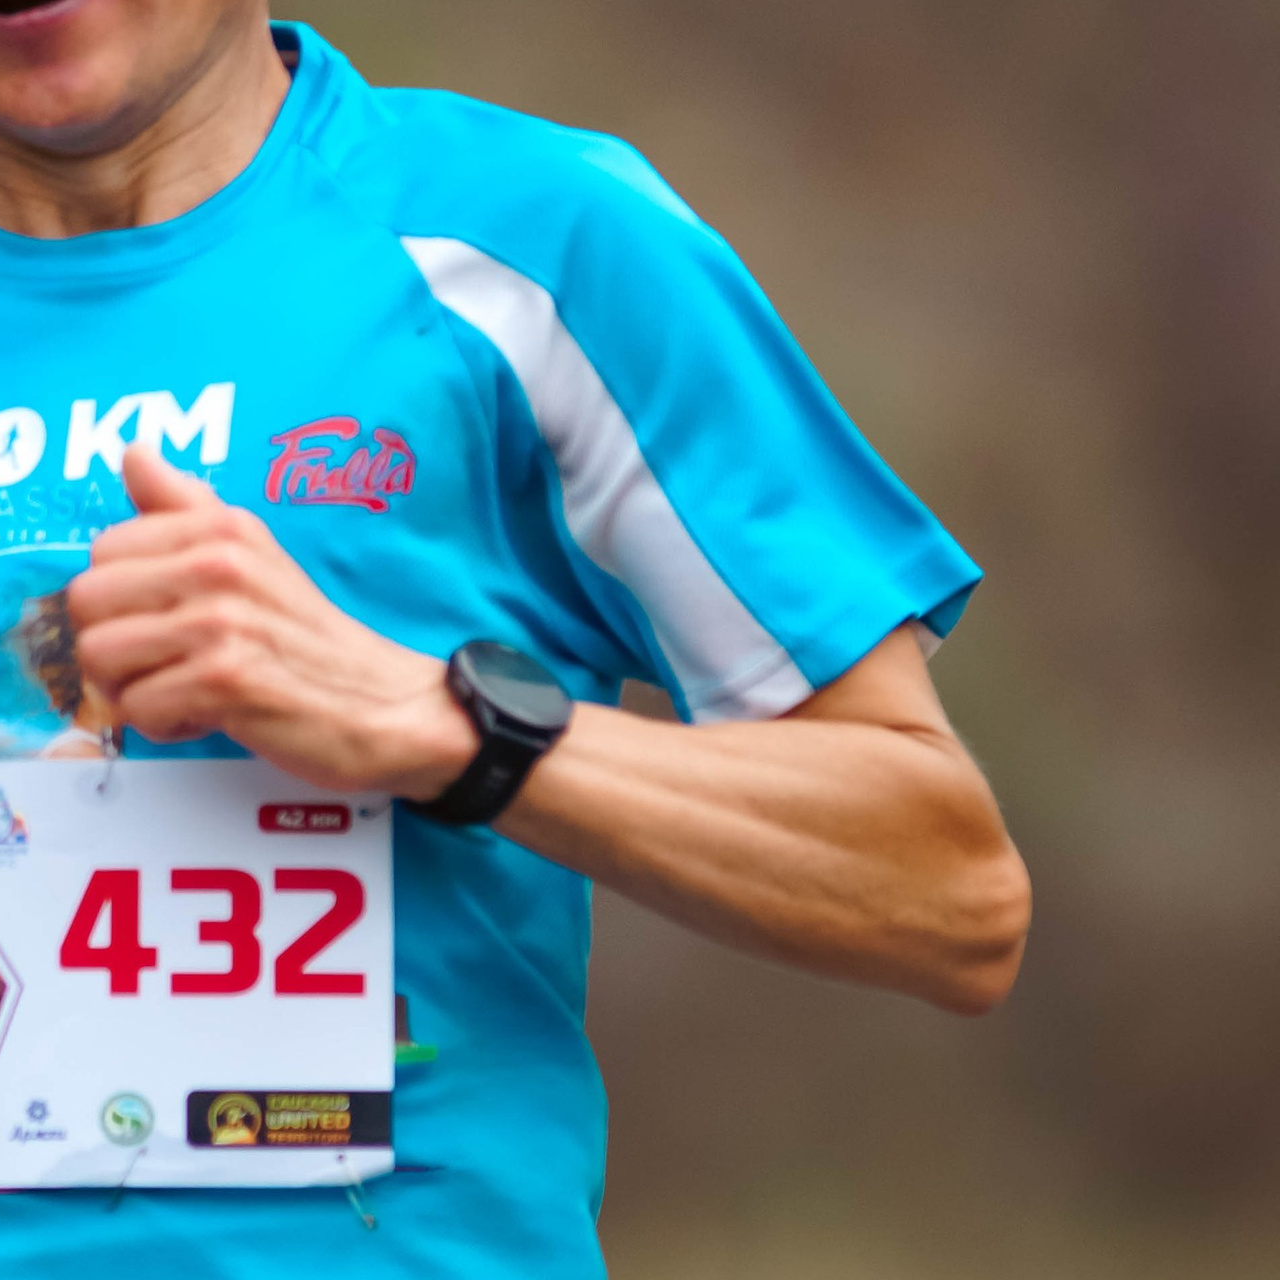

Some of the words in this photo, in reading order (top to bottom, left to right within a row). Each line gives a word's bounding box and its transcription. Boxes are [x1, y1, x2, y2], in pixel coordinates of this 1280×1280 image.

[63, 381, 235, 481] KM
[59, 868, 367, 995] 432
[266, 1110, 351, 1130] UNITED
